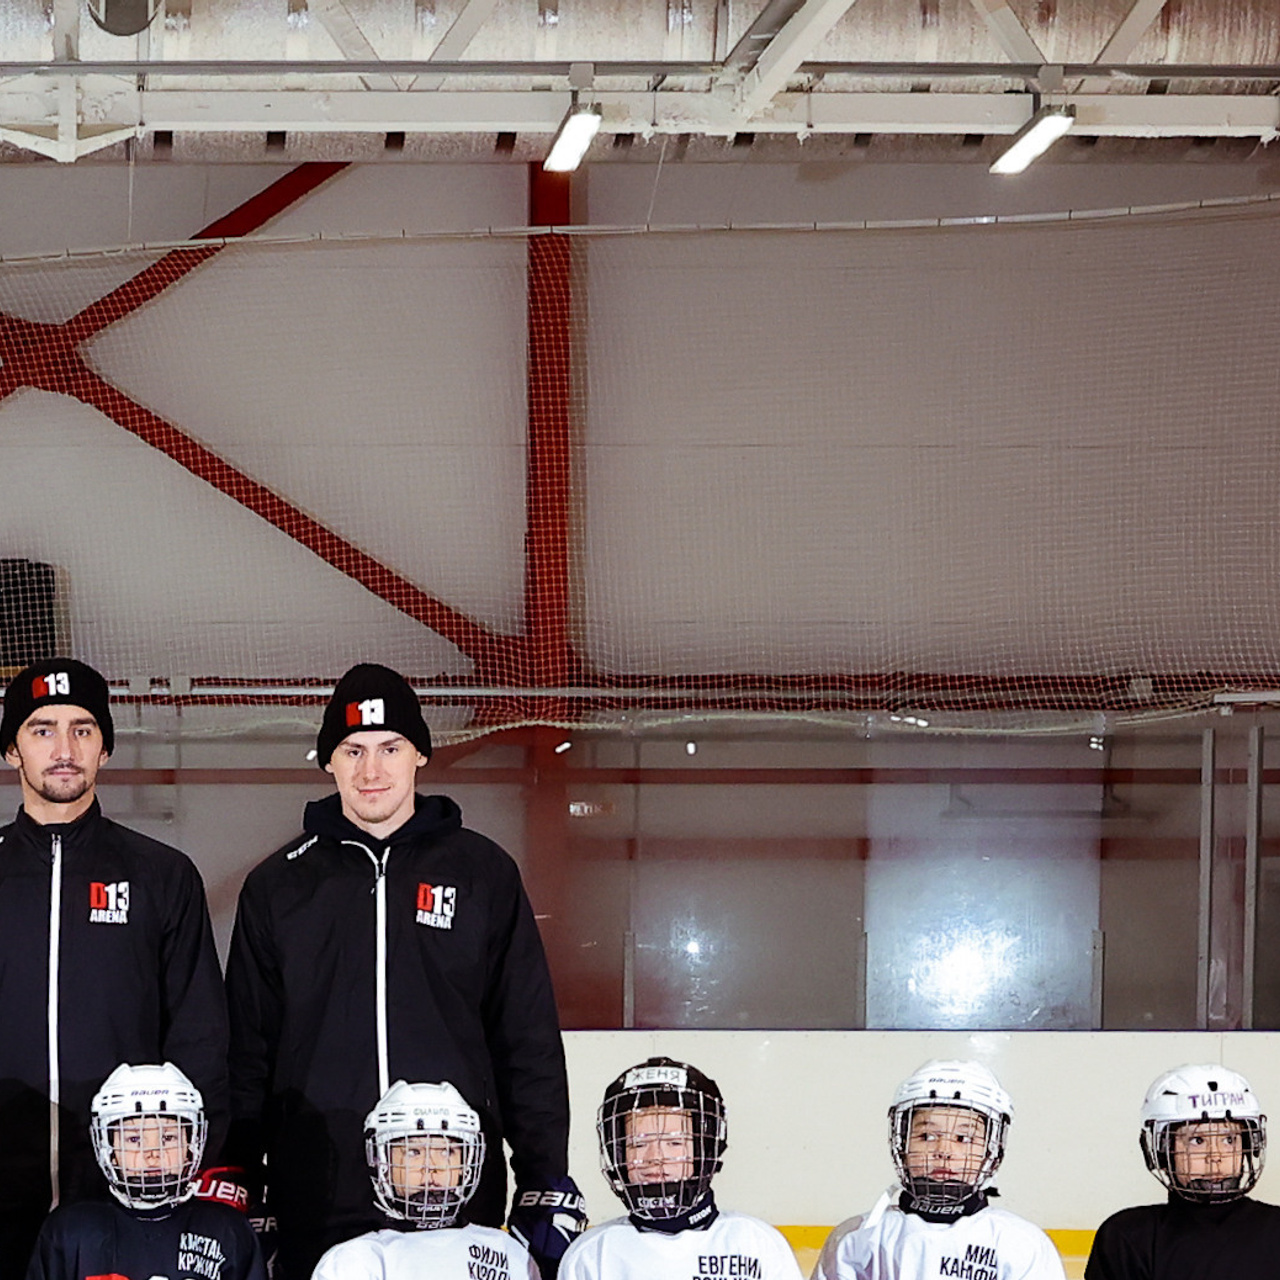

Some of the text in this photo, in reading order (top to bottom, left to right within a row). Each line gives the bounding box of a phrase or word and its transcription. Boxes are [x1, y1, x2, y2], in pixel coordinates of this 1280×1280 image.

[31, 672, 70, 699] D13
[346, 698, 385, 727] D13
[89, 881, 130, 911] D13
[417, 882, 457, 918] D13
[89, 908, 128, 925] ARENA
[416, 909, 453, 930] ARENA
[183, 1177, 250, 1205] UER
